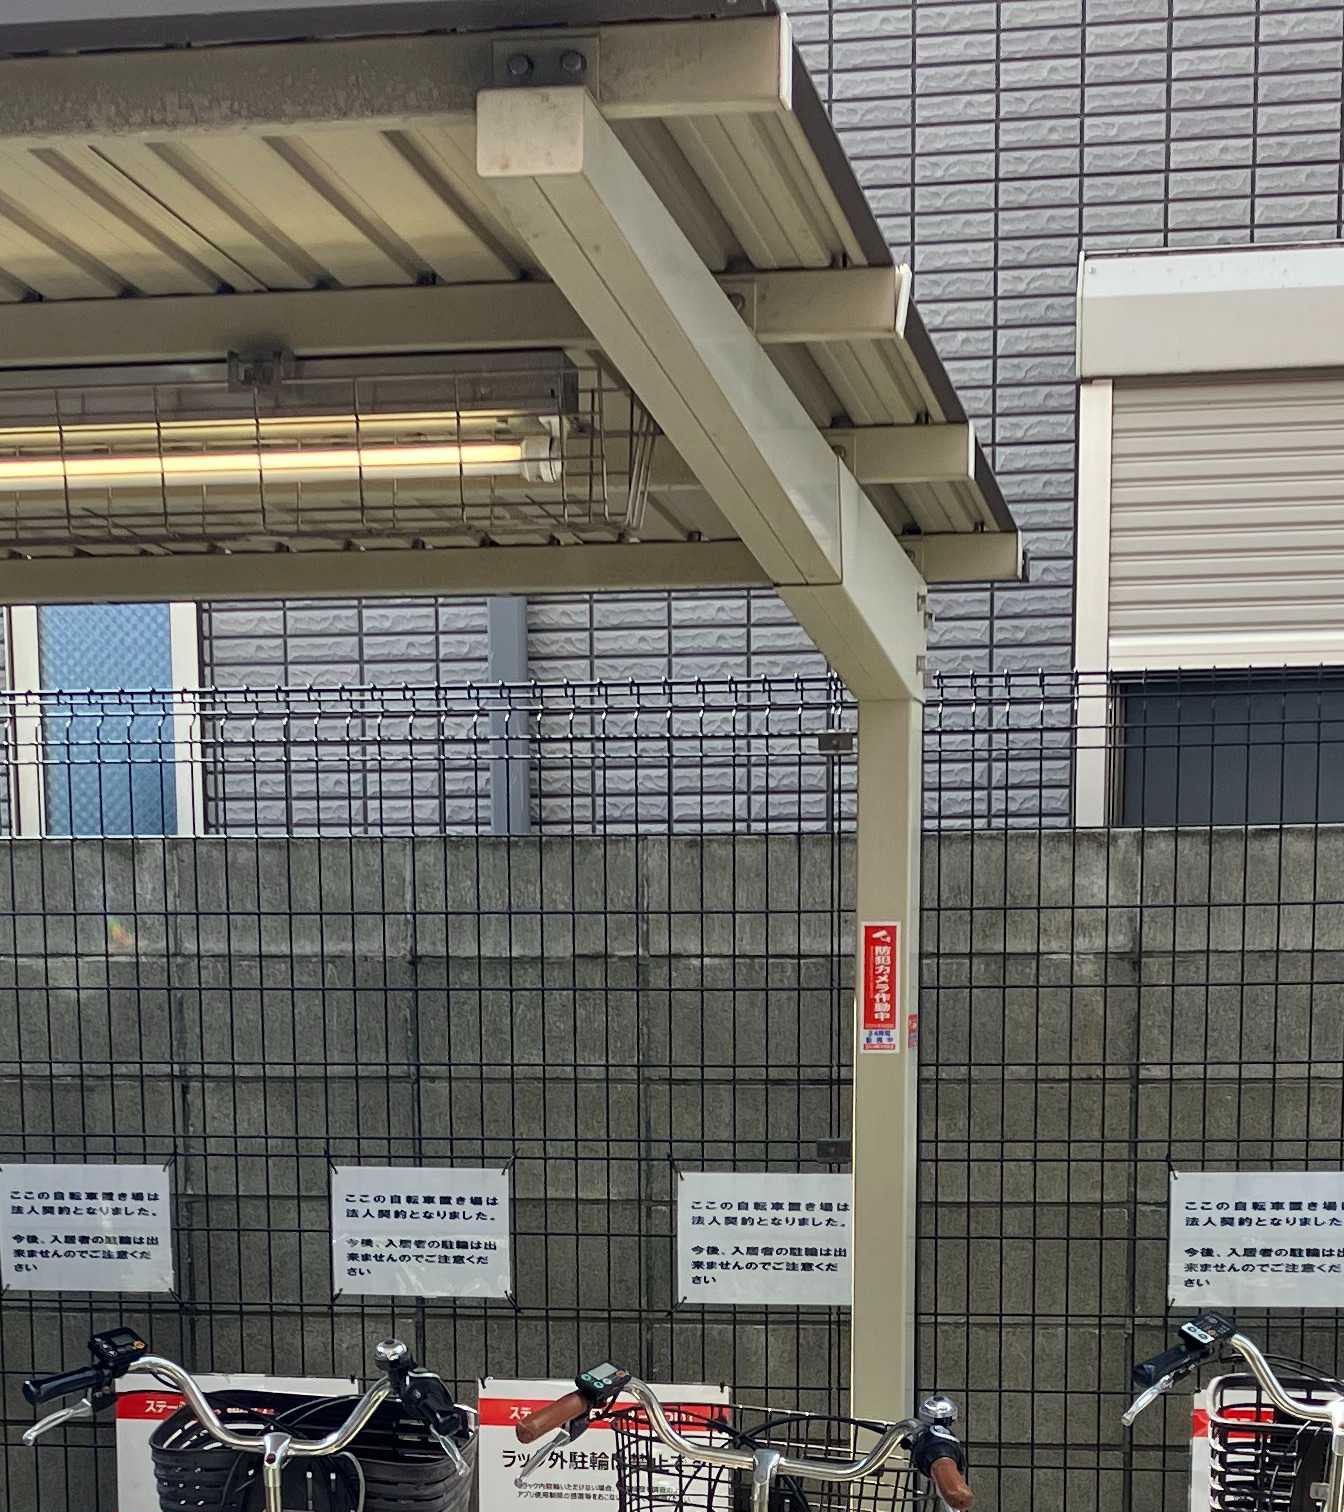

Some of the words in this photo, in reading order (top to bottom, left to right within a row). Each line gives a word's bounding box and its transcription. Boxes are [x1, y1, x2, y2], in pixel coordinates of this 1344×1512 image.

[14, 1263, 38, 1273] さい
[346, 1267, 372, 1277] さい
[691, 1275, 717, 1285] さい
[1184, 1278, 1211, 1288] さい
